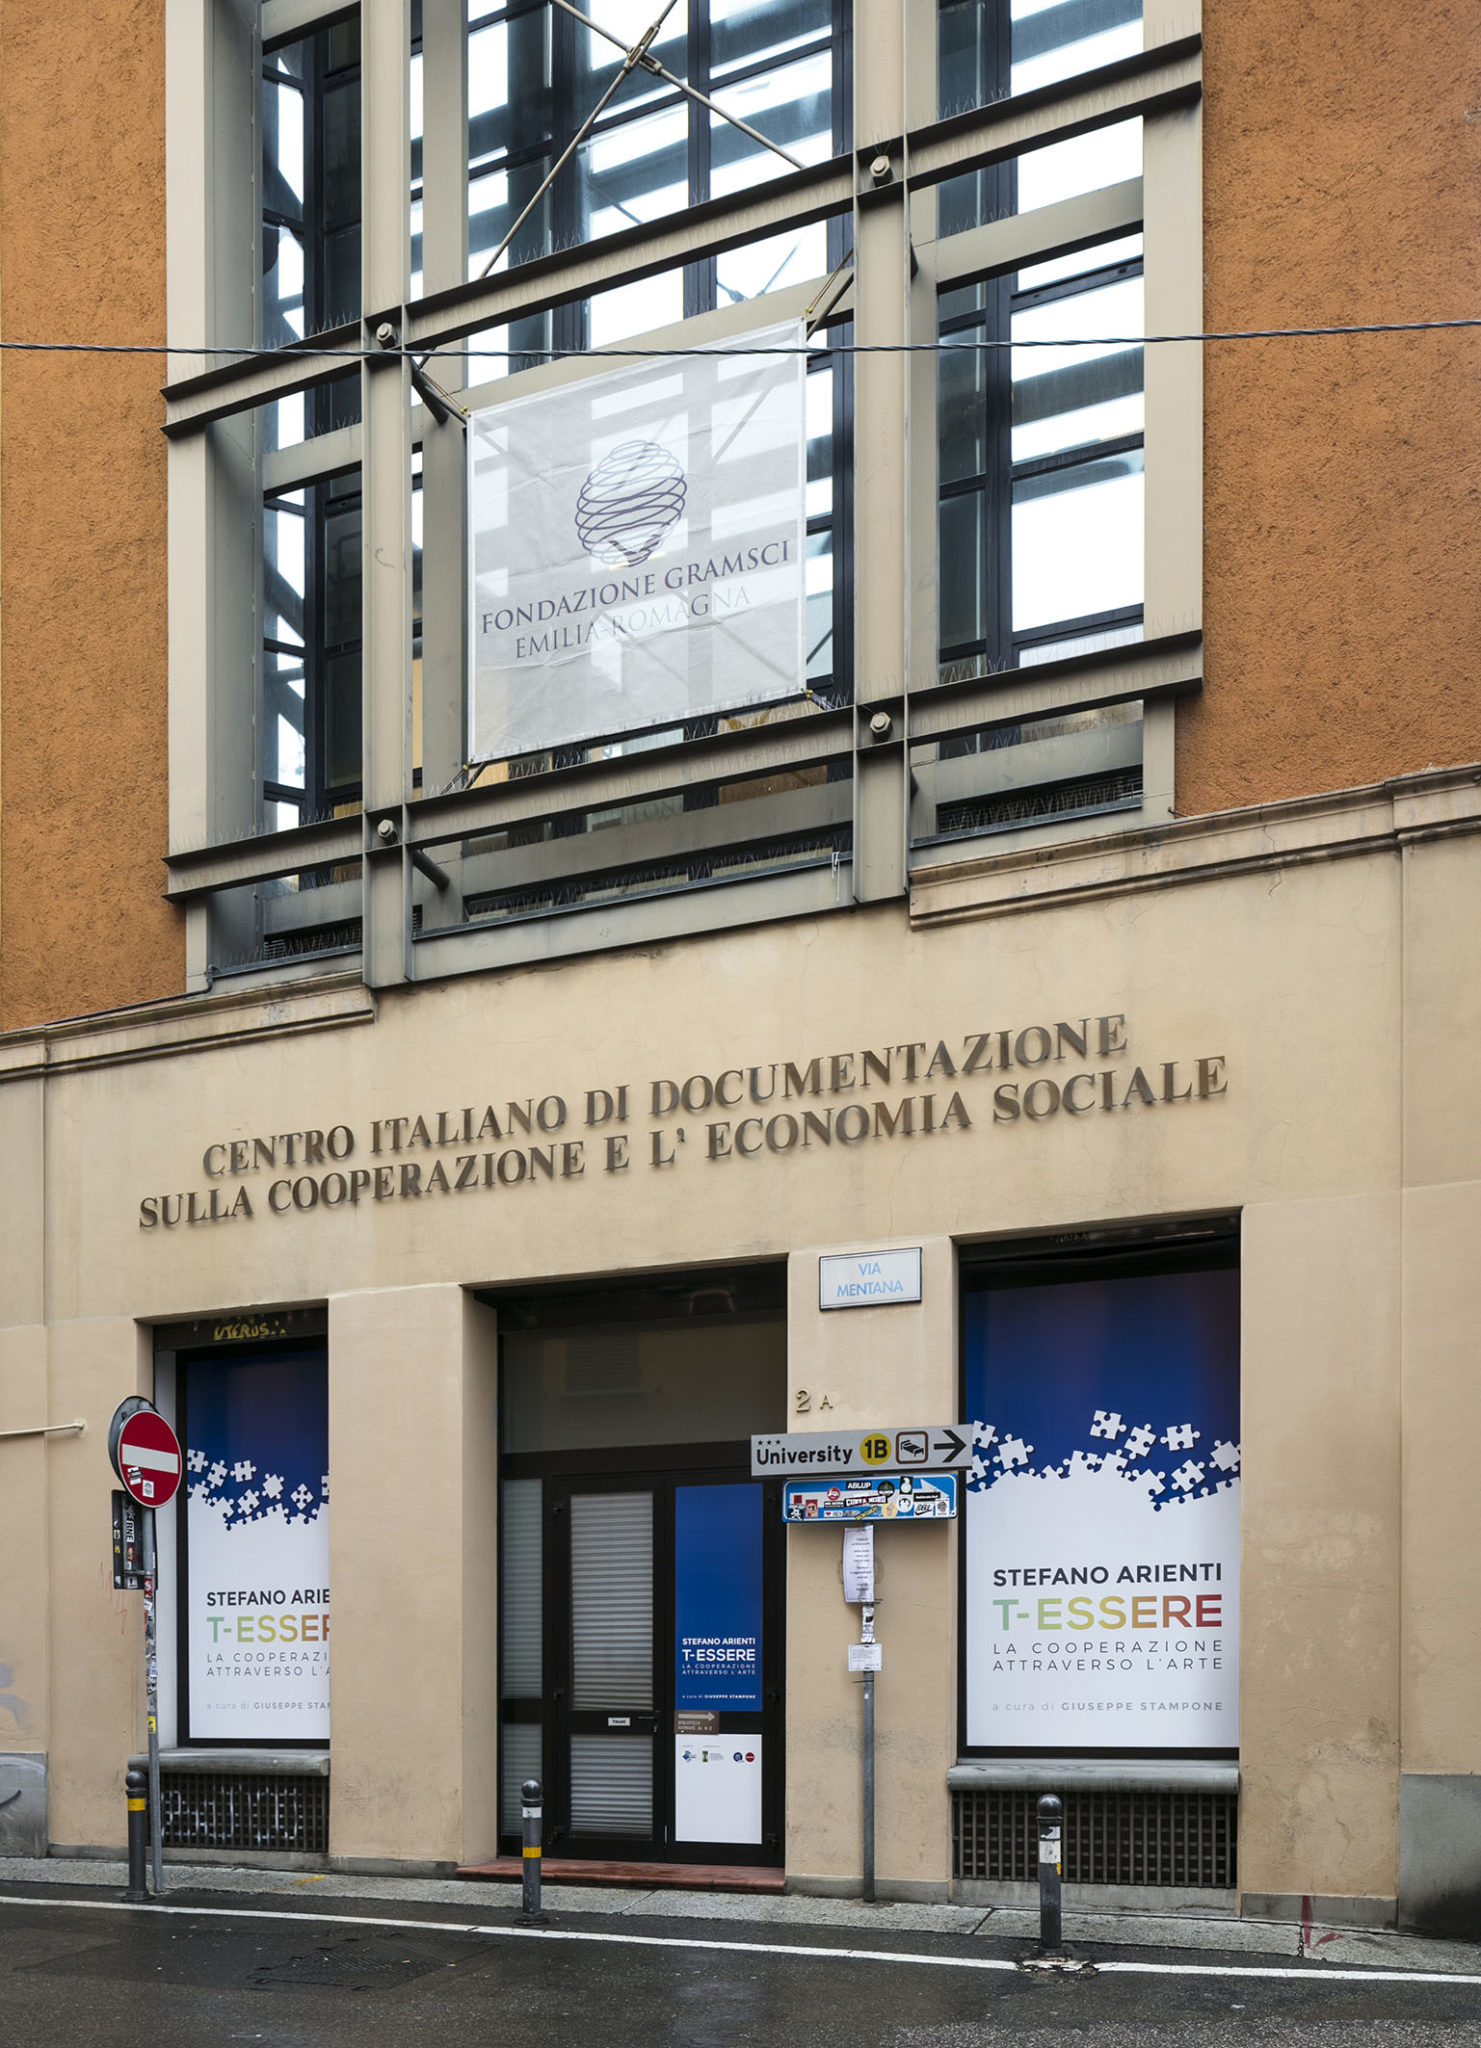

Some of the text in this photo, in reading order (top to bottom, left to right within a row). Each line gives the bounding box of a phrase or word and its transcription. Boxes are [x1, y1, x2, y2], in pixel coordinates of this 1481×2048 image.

[481, 540, 790, 634] FONDAZIONE GRAMSCI
[203, 1013, 1128, 1177] CENTRO ITALIANO DI DOCUMENTAZIONE
[139, 1185, 254, 1228] SULLA
[268, 1140, 585, 1211] COOPERAZIONE
[603, 1135, 630, 1171] E
[993, 1055, 1229, 1122] SOCIALE
[858, 1262, 882, 1276] VIA
[836, 1279, 903, 1298] MENTANA
[795, 1389, 833, 1414] 2 A
[756, 1439, 888, 1466] University 1B
[993, 1562, 1222, 1587] STEFANO ARIENTI
[207, 1589, 330, 1606] STEFANO ARIE
[992, 1594, 1222, 1631] T-ESSERE
[682, 1649, 756, 1661] T-ESSERE
[994, 1640, 1222, 1654] LA COOPERAZIONE
[207, 1652, 327, 1663] LA COOPERAZI
[993, 1657, 1222, 1671] ATTRAVERSO L'ARTE
[206, 1666, 303, 1676] ATTRAVERSO
[240, 1701, 250, 1709] di
[1005, 1703, 1035, 1711] cura
[1041, 1702, 1054, 1711] di
[1061, 1702, 1133, 1711] GIUSEPPE
[1140, 1702, 1223, 1711] STAMPONE
